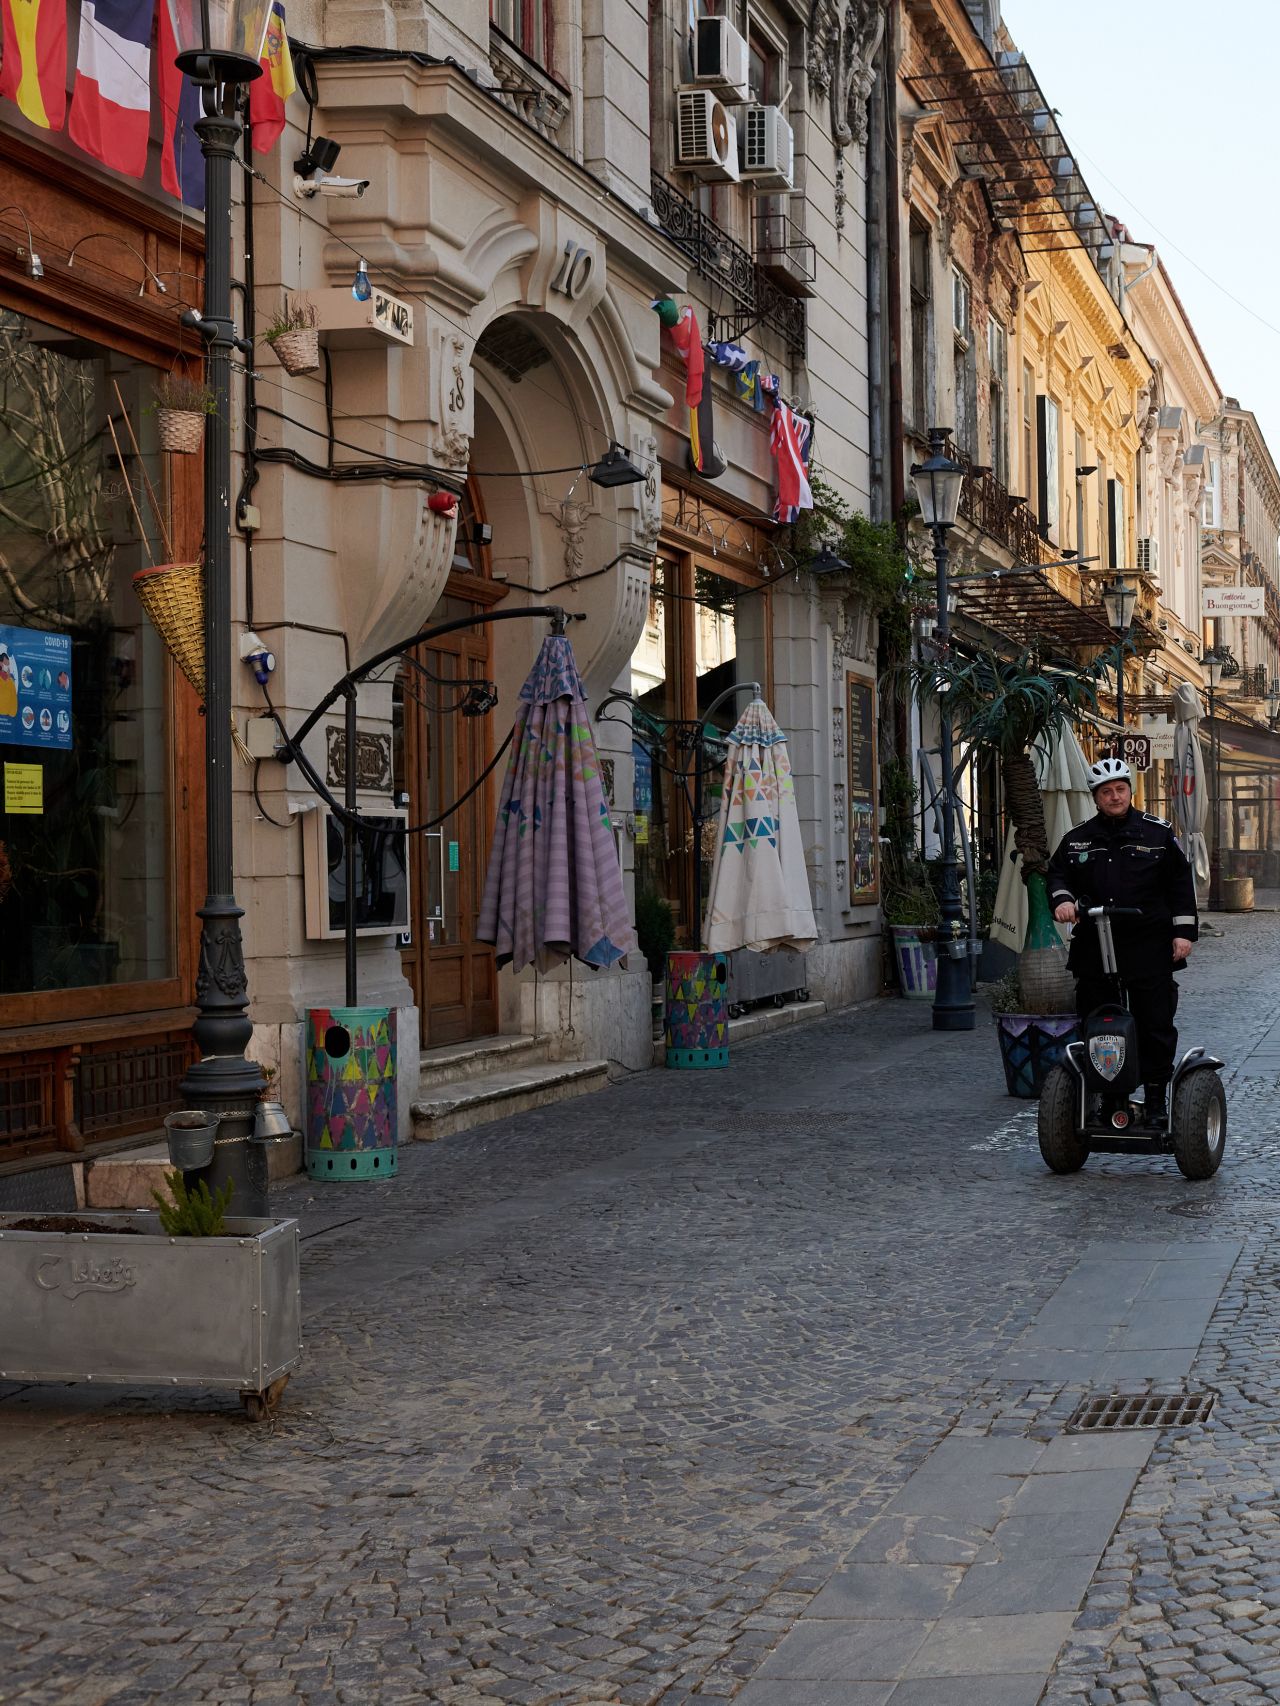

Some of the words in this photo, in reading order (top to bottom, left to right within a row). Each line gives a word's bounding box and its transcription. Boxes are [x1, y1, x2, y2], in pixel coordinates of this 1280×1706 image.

[550, 239, 596, 301] 10
[44, 636, 69, 649] COVID-19
[32, 1253, 137, 1300] Clsberg
